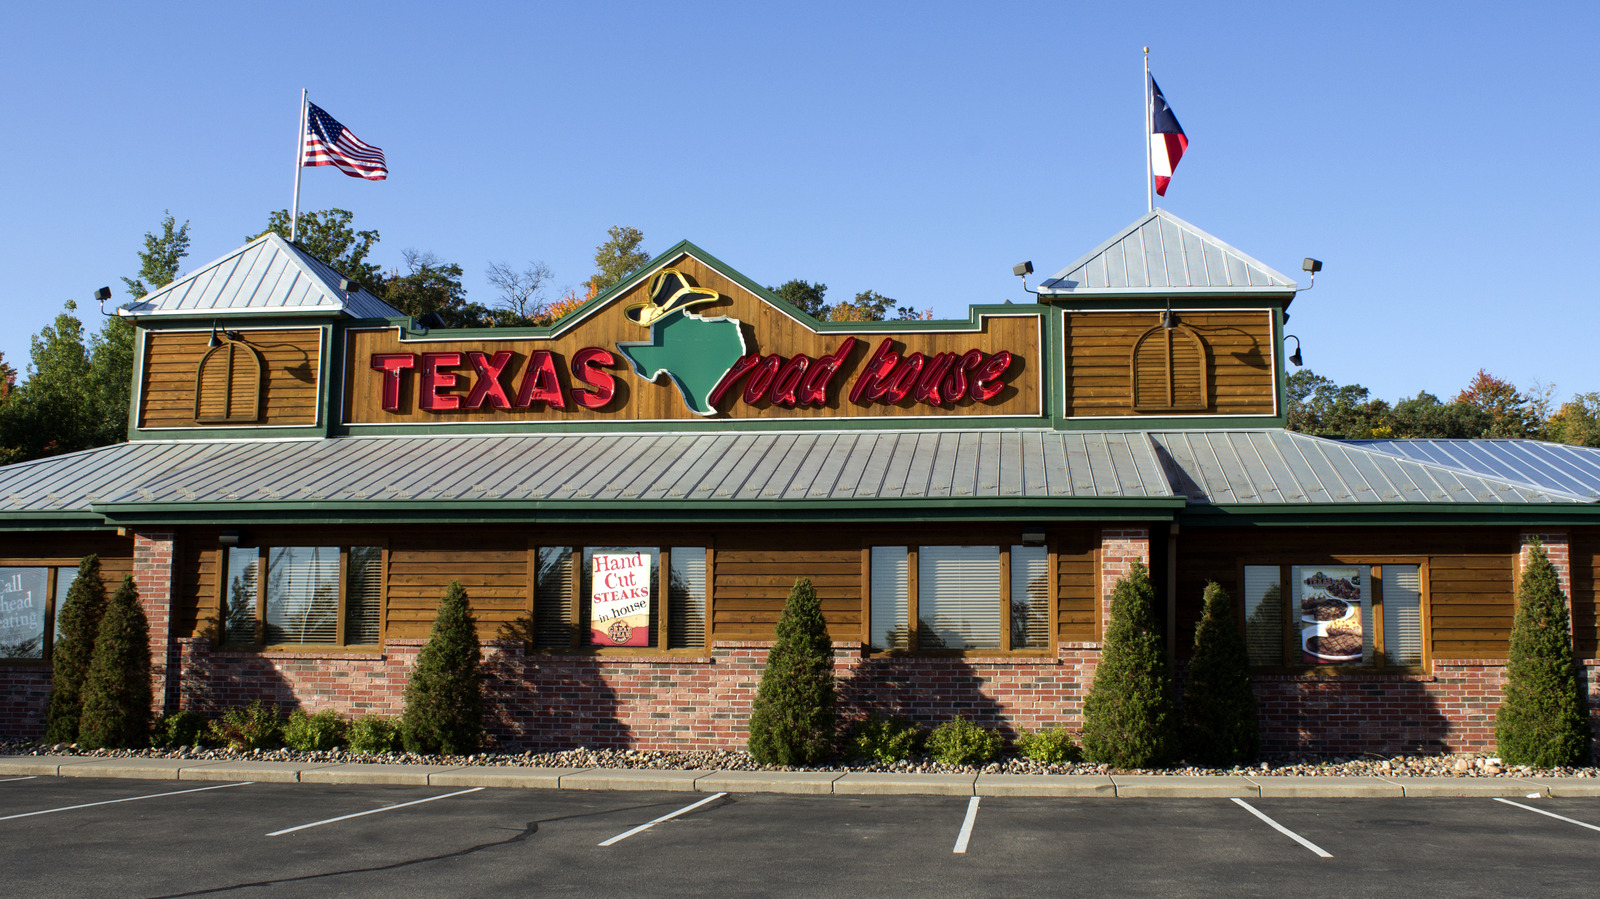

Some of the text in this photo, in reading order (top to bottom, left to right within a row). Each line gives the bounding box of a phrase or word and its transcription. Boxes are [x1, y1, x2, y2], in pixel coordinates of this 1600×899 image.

[371, 336, 1012, 410] TEXAS road house
[593, 551, 643, 573] Hand
[604, 571, 637, 589] Cut
[593, 586, 649, 604] STEAKS
[0, 612, 37, 629] ating
[599, 600, 647, 623] in house
